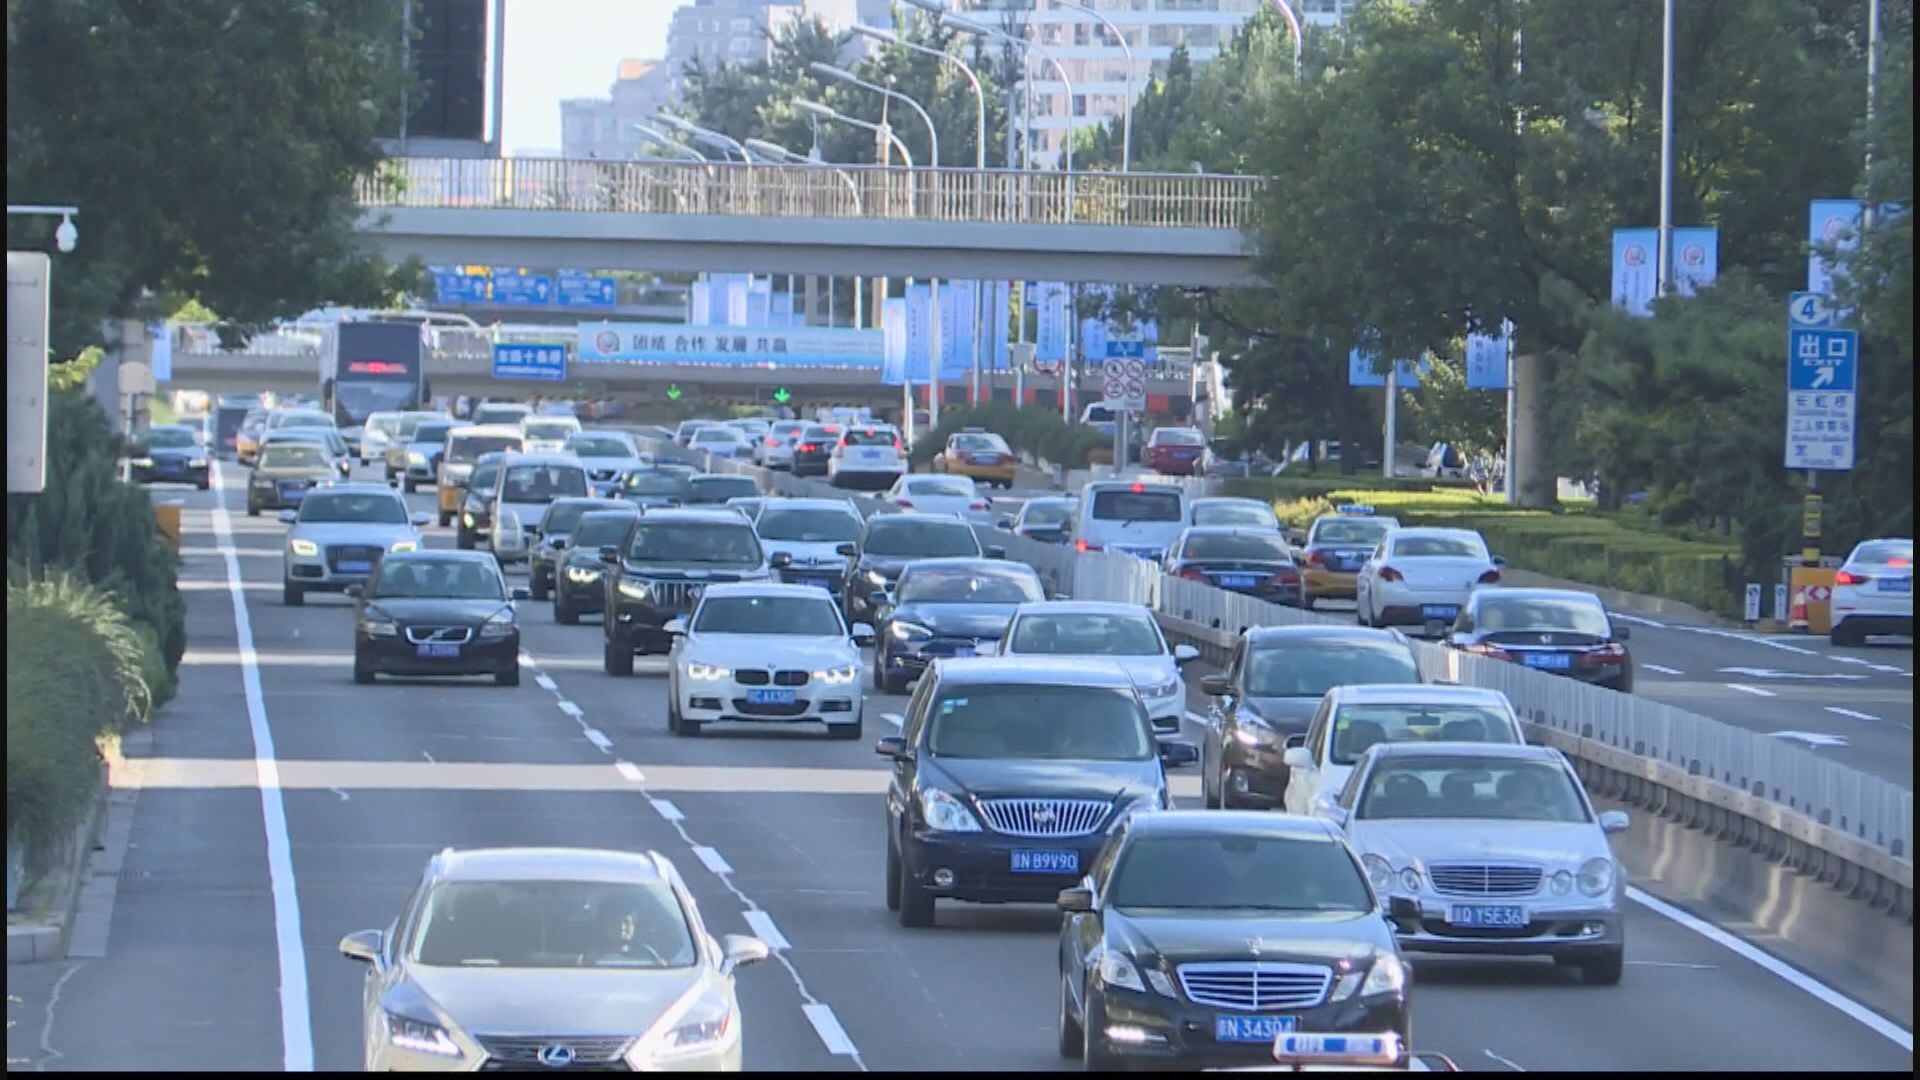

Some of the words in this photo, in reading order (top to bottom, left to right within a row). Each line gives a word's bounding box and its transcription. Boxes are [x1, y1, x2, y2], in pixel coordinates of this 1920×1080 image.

[1802, 299, 1815, 320] 4
[632, 334, 666, 351] 团结
[674, 334, 705, 352] 合作
[715, 335, 747, 353] 发展
[756, 337, 787, 353] 共赢
[1799, 334, 1847, 358] 出口
[1802, 358, 1843, 367] EXIT
